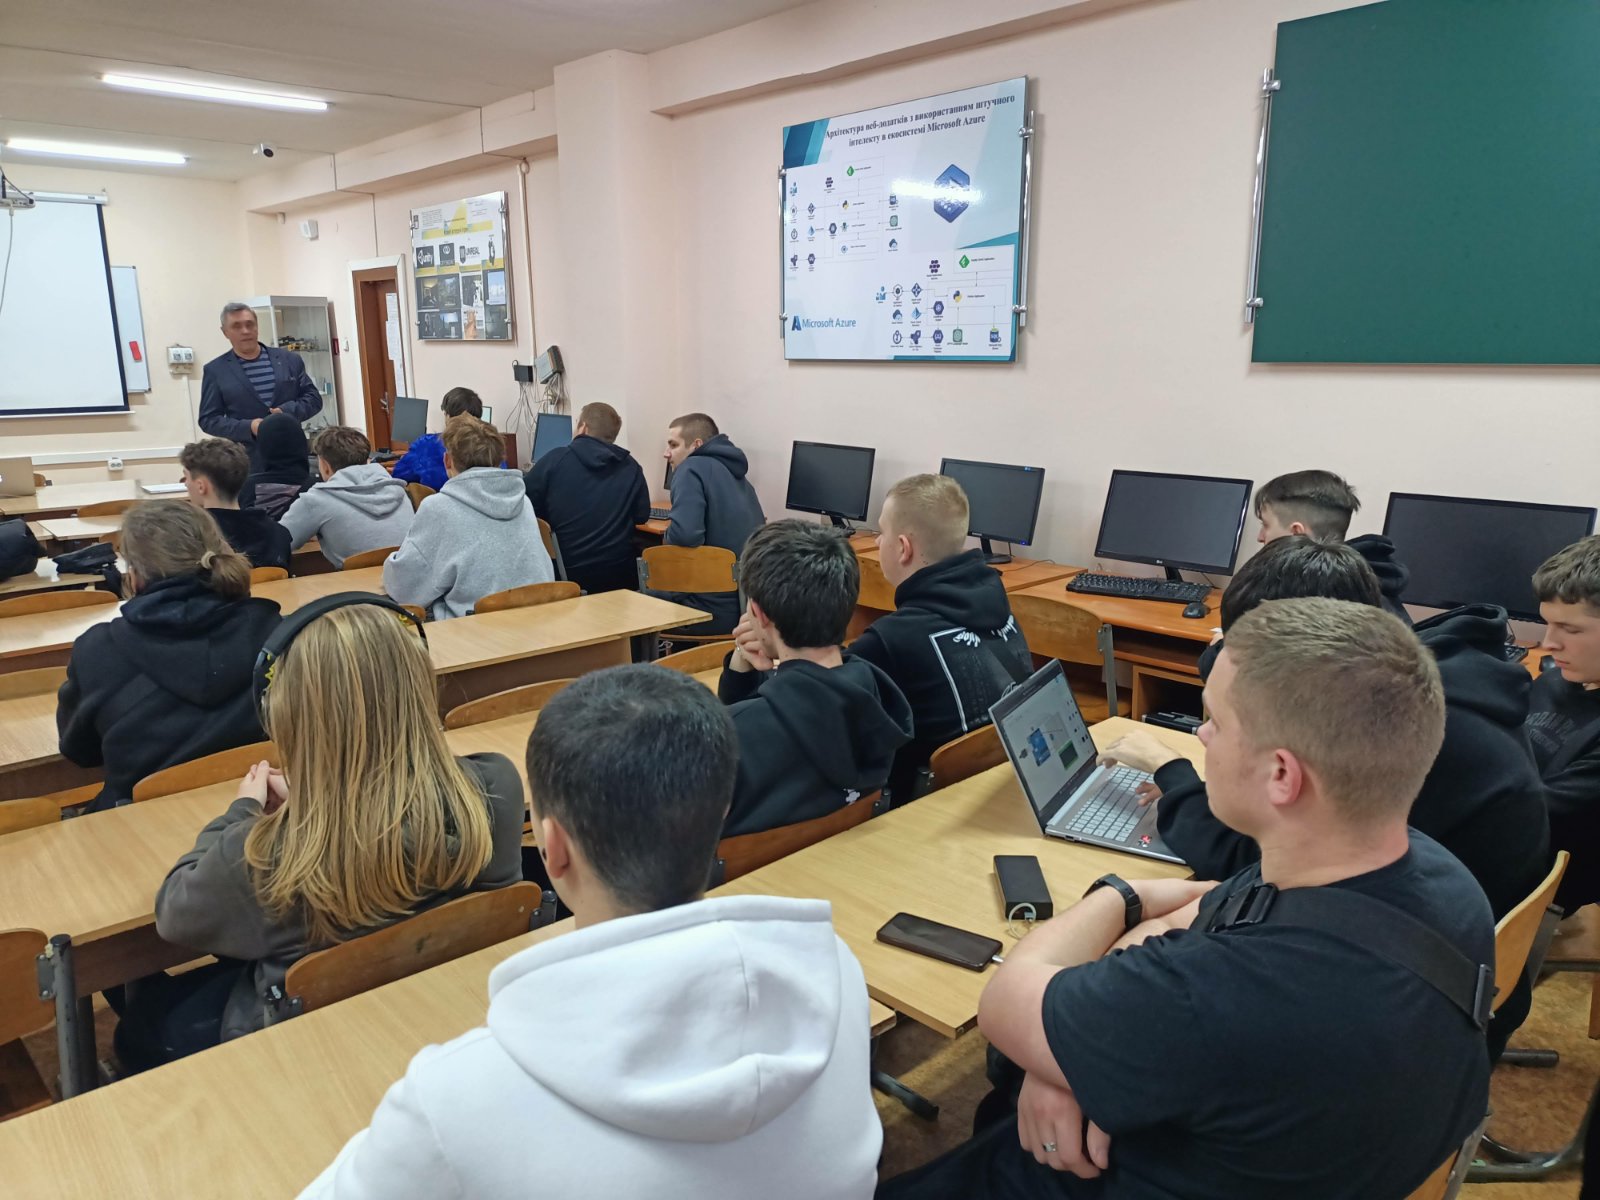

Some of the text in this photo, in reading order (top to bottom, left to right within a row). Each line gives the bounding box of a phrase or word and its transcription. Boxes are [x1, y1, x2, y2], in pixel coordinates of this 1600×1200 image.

[826, 125, 864, 139] Архітектура
[866, 115, 908, 130] веб-додатків
[915, 103, 974, 121] використанням
[976, 95, 1015, 109] штучного
[849, 135, 880, 146] інтелекту
[888, 124, 926, 140] екосистемі
[927, 117, 961, 132] Microsoft
[963, 115, 986, 126] Azure
[802, 318, 857, 328] Microsoft Azure
